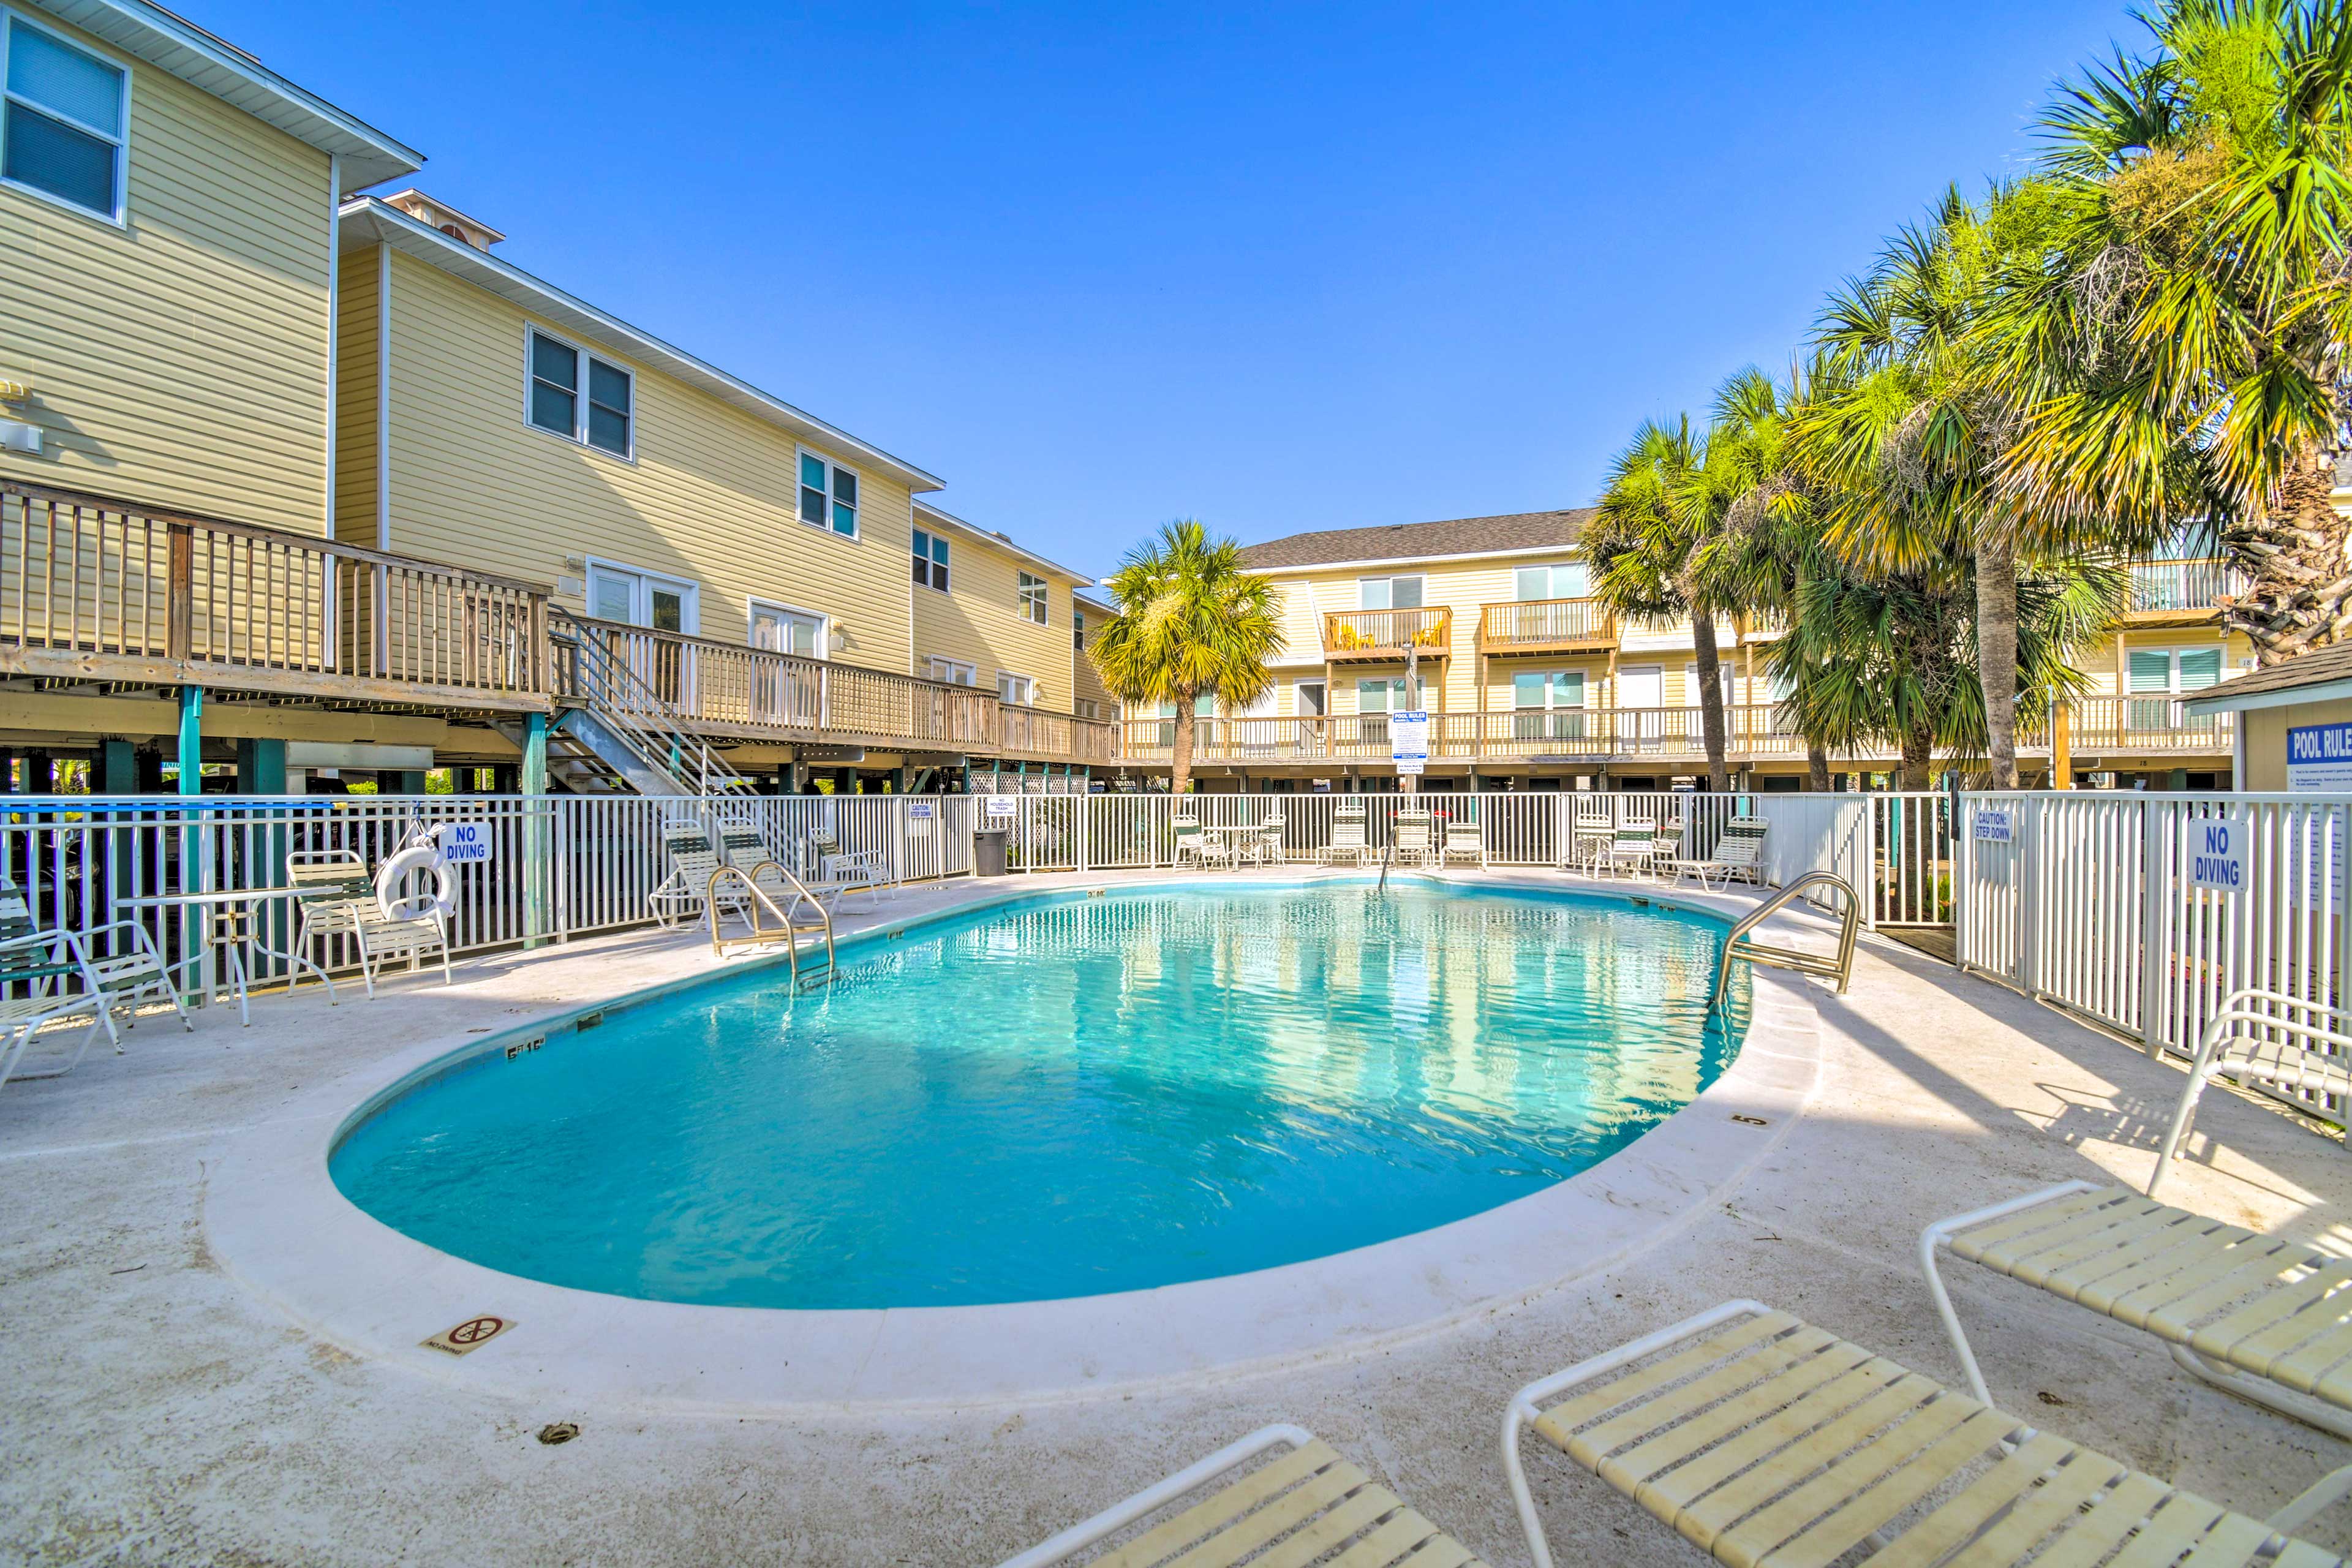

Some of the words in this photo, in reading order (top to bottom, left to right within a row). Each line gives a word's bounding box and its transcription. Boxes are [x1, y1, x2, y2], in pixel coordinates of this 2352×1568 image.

[2294, 731, 2321, 759] POOL
[1978, 813, 2006, 825] CAUTION:
[456, 826, 475, 842] NO
[1976, 826, 1989, 837] STEP
[1991, 827, 2009, 840] DOWN
[2206, 826, 2228, 854] NO
[447, 844, 484, 859] DIVING
[2196, 857, 2239, 886] DIVING
[1732, 1115, 1766, 1125] 5
